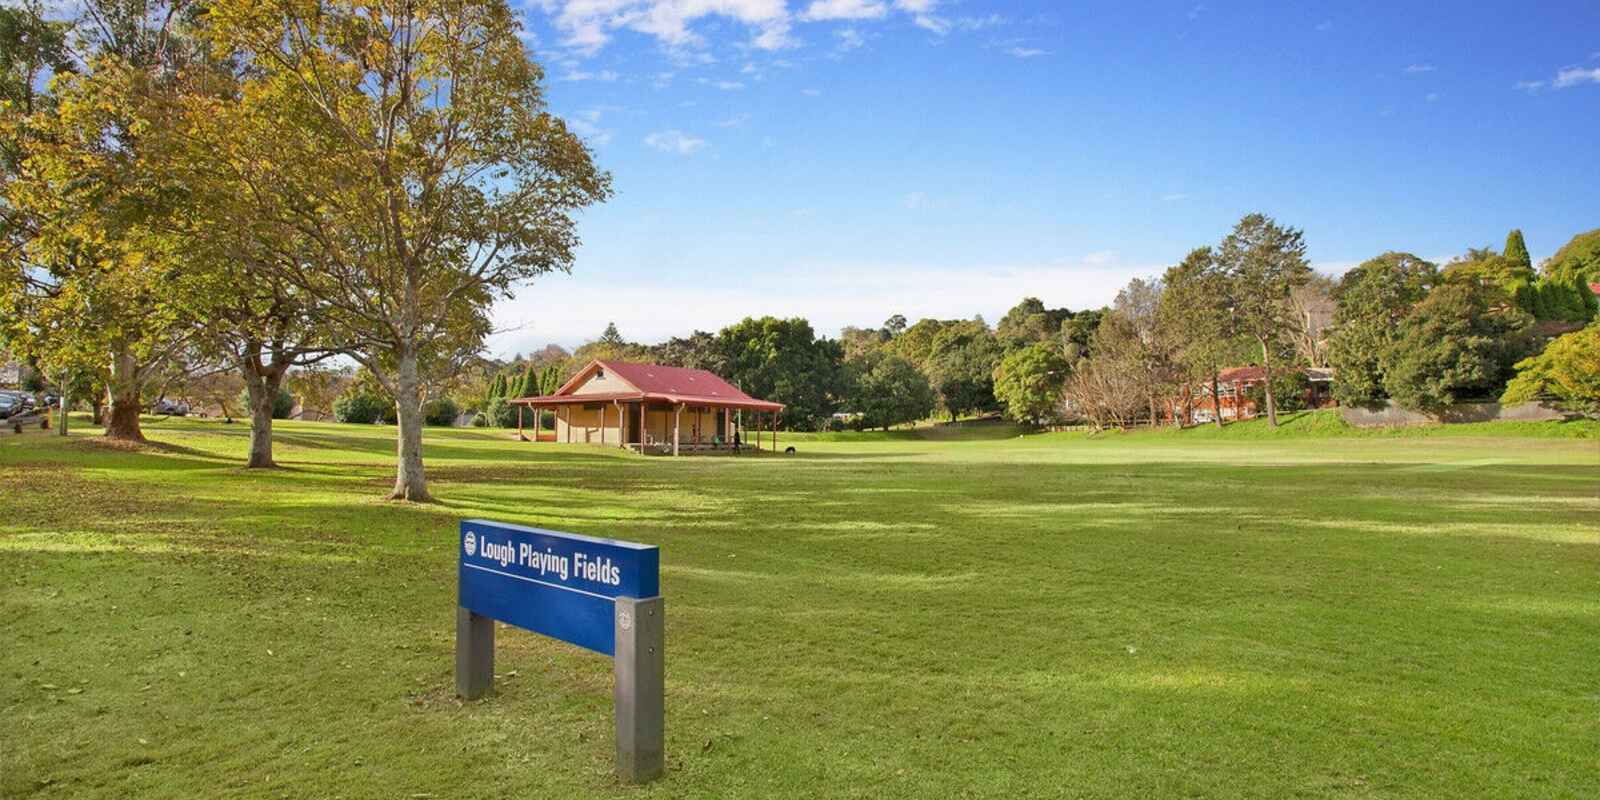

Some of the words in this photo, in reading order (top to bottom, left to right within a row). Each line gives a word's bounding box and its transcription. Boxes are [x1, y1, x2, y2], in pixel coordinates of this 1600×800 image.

[480, 535, 515, 567] Lough
[519, 543, 568, 581] Playing
[573, 553, 620, 586] Fields
